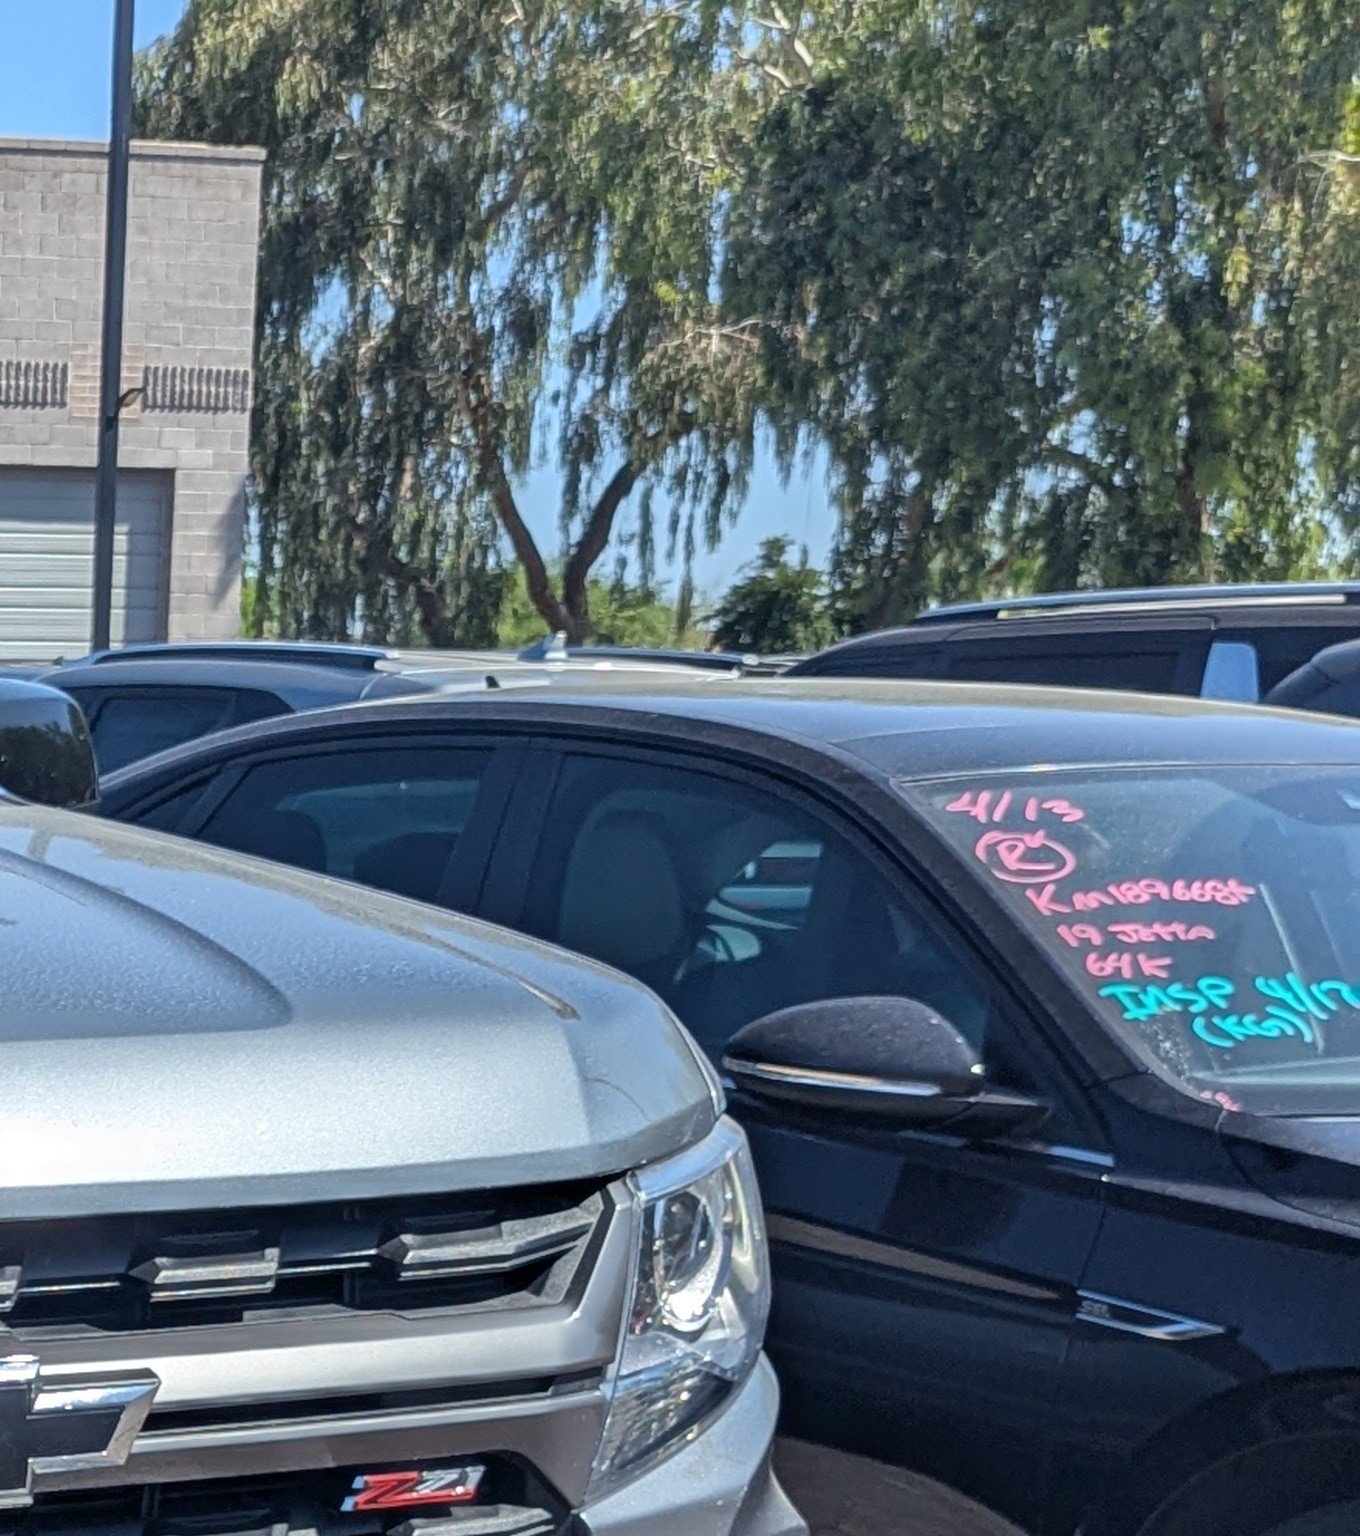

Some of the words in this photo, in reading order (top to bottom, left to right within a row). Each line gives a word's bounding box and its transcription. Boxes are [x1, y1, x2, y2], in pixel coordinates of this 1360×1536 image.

[946, 789, 1084, 823] 4/13
[1057, 923, 1103, 948] 19
[340, 1465, 487, 1512] Z71
